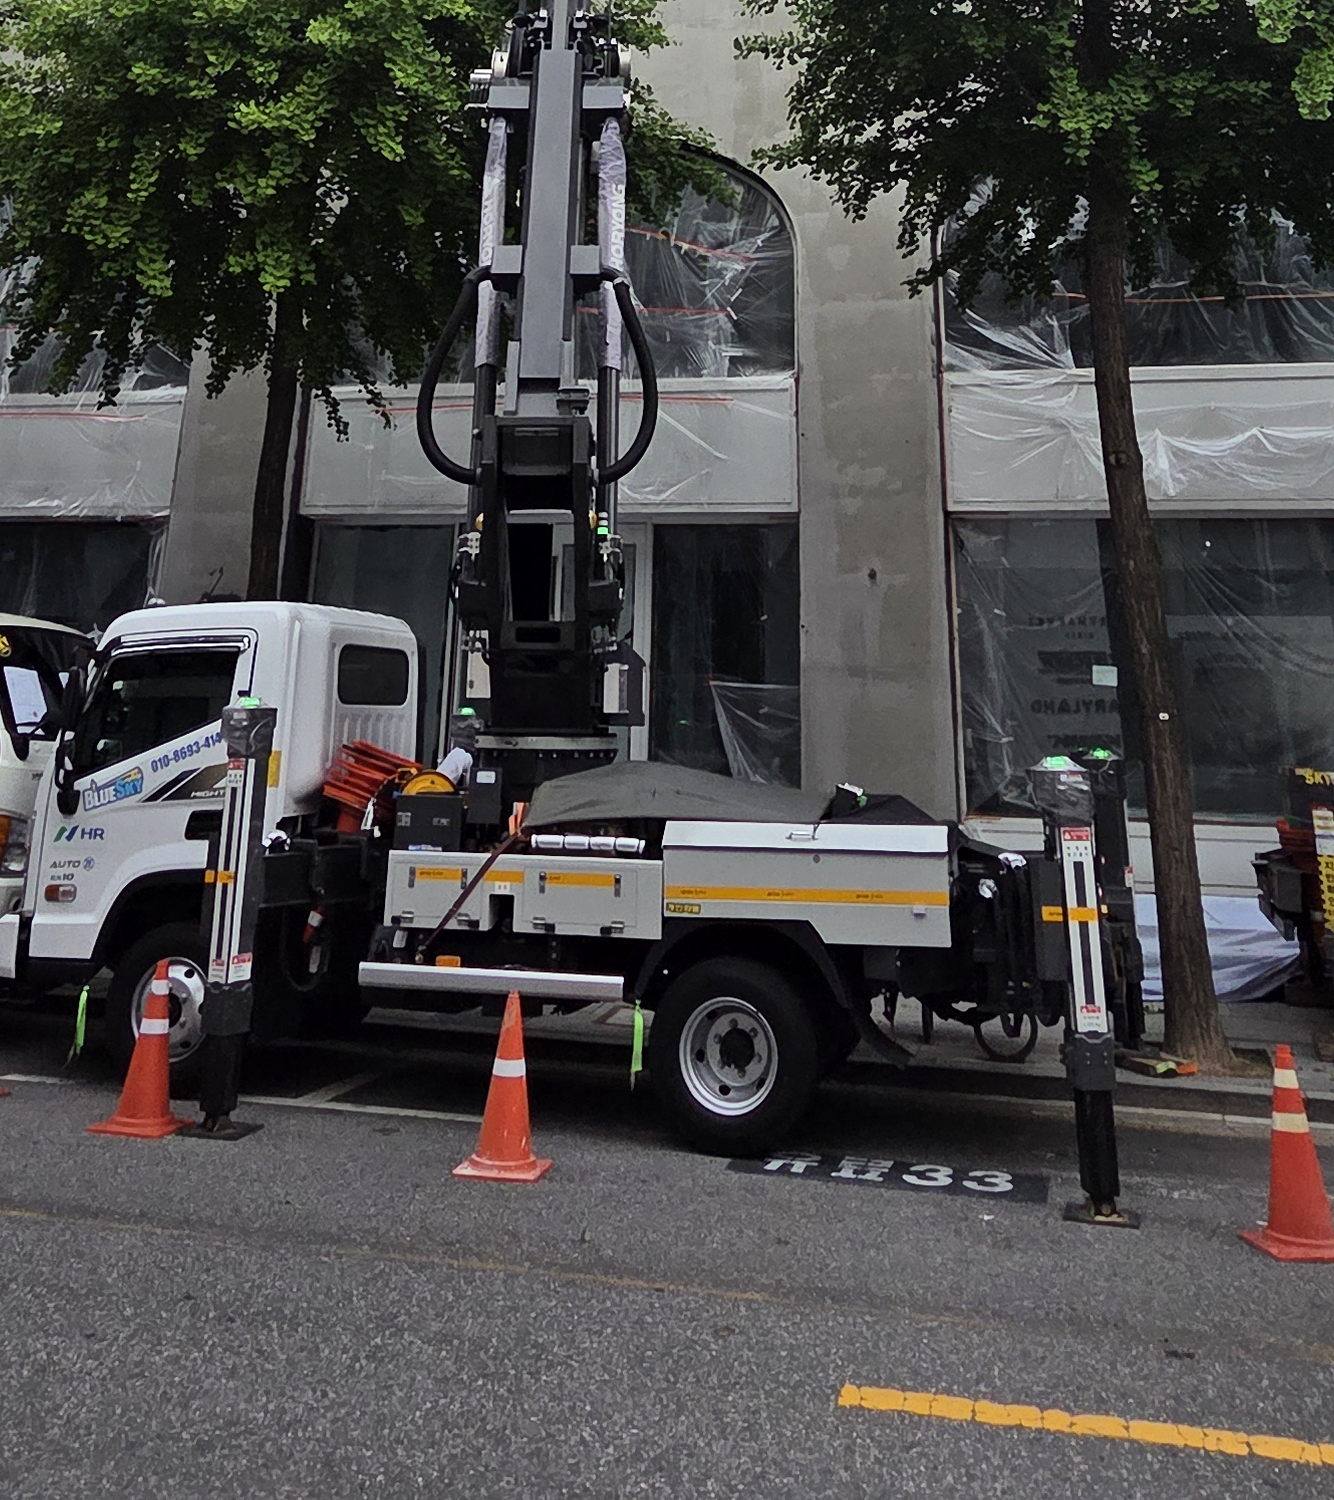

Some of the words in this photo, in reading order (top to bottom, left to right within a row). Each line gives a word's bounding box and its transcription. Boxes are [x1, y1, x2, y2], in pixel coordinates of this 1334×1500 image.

[610, 184, 626, 271] HORYONG
[150, 732, 222, 773] 010-8693-414
[190, 789, 226, 798] MIGHT
[80, 827, 105, 841] HR
[50, 860, 81, 869] AUTO
